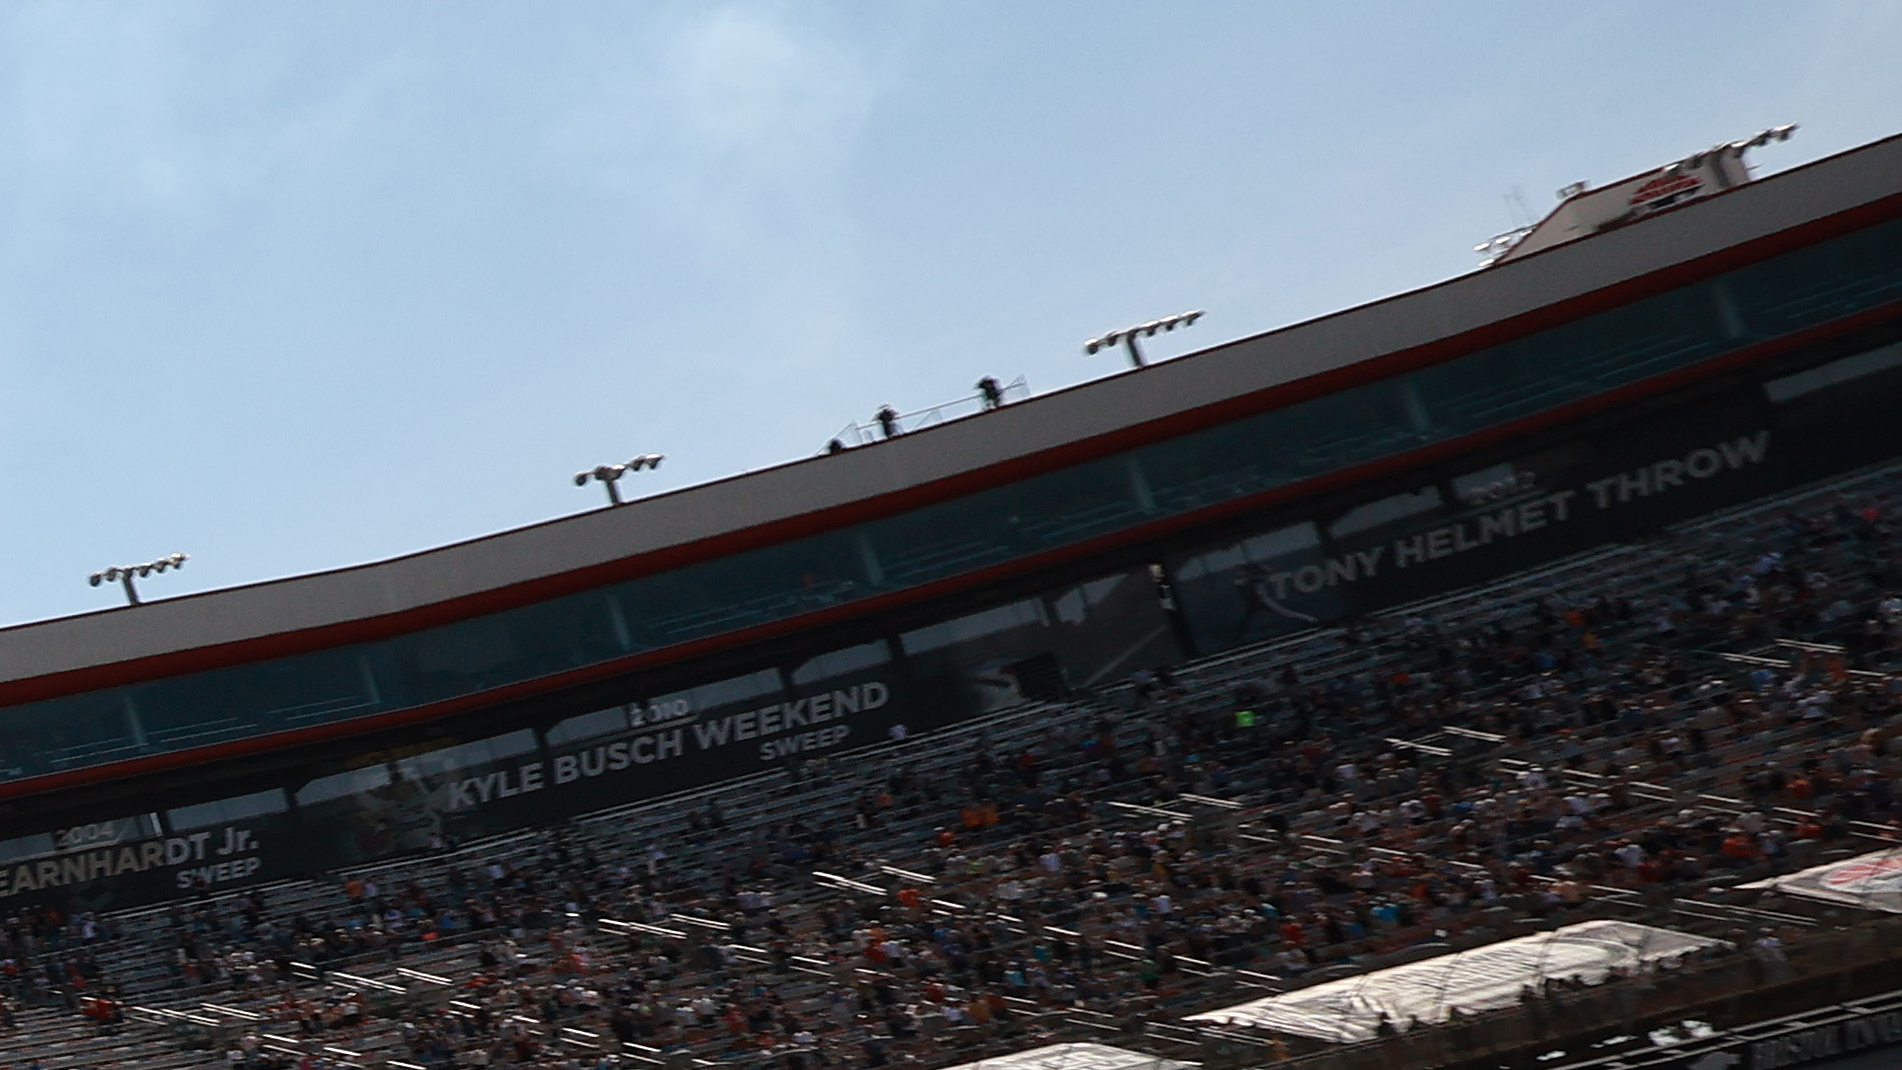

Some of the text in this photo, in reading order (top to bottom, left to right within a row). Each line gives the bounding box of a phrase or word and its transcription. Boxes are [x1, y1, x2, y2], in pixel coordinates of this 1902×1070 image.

[1270, 430, 1772, 601] TONY HELMET THROW
[446, 681, 890, 811] KYLE BUSCH WEEKEND
[759, 724, 851, 762] SWEEP
[215, 826, 259, 856] Jr.
[177, 858, 262, 890] SWEEP
